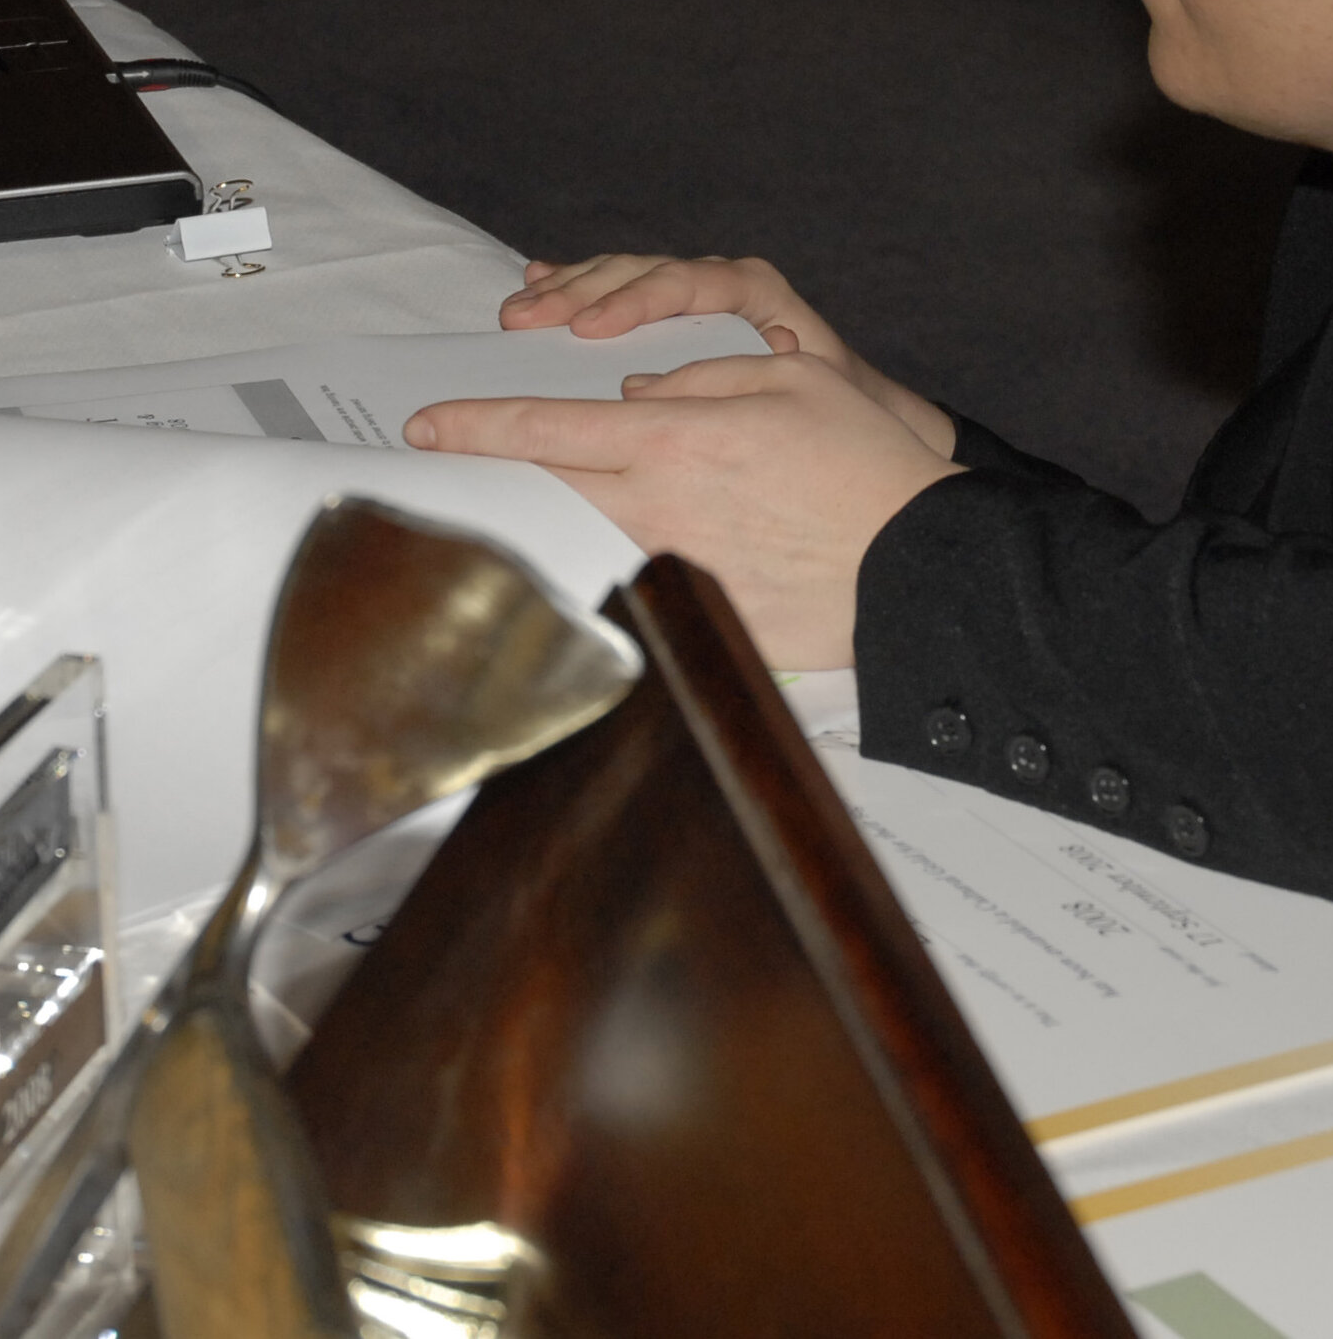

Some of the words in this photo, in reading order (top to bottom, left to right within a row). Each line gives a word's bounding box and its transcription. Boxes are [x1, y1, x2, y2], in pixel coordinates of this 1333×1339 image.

[1058, 843, 1115, 873] 2008
[1061, 899, 1132, 937] 2008
[1107, 872, 1201, 931] September
